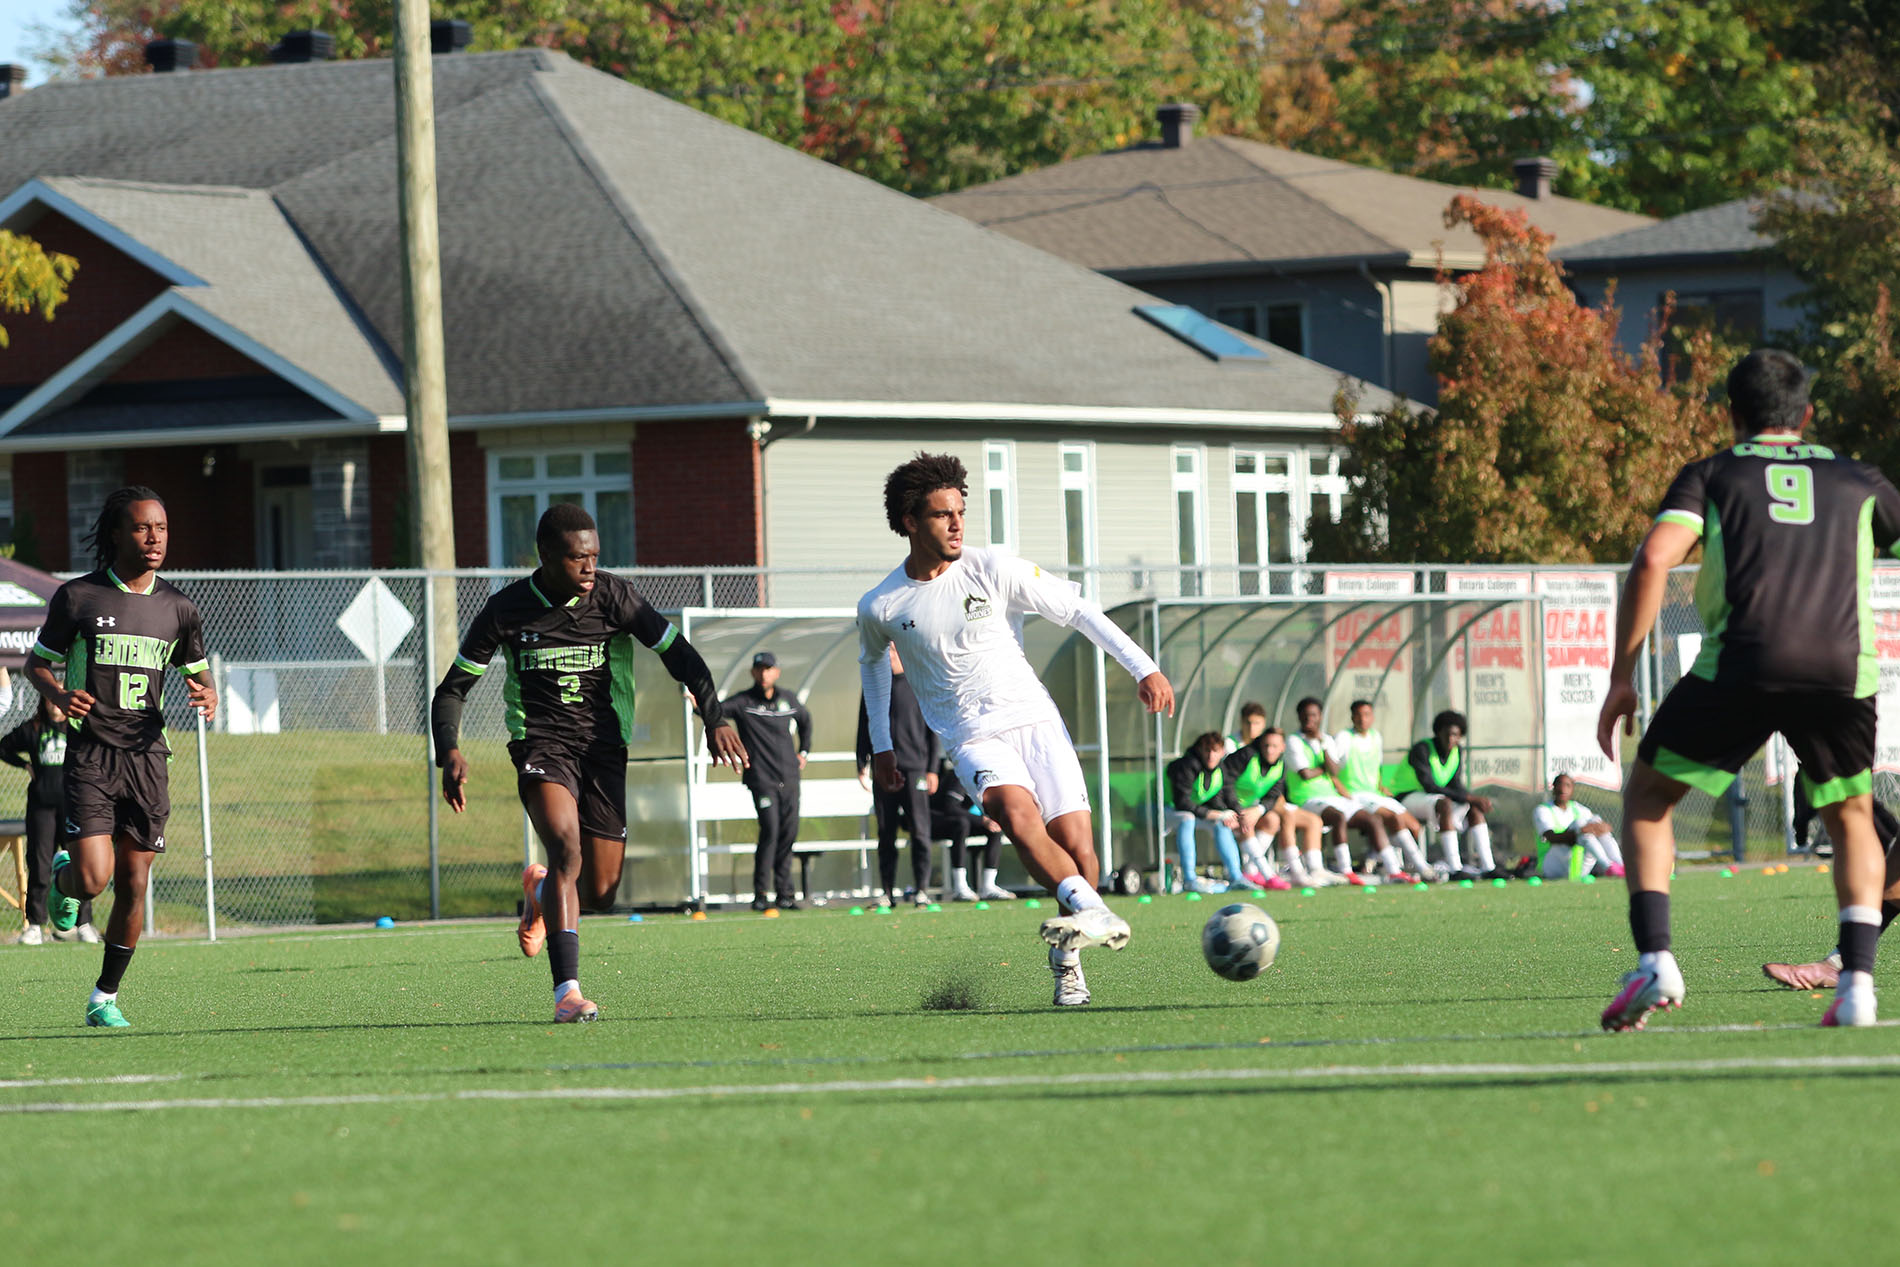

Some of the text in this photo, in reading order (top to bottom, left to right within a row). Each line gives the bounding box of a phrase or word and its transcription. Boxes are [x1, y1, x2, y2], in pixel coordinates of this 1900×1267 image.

[1764, 463, 1815, 525] 9
[1545, 608, 1608, 642] OCAA
[119, 672, 150, 710] 12
[557, 674, 585, 704] 2
[1563, 672, 1593, 688] MEN'S
[1560, 689, 1597, 705] SOCCER
